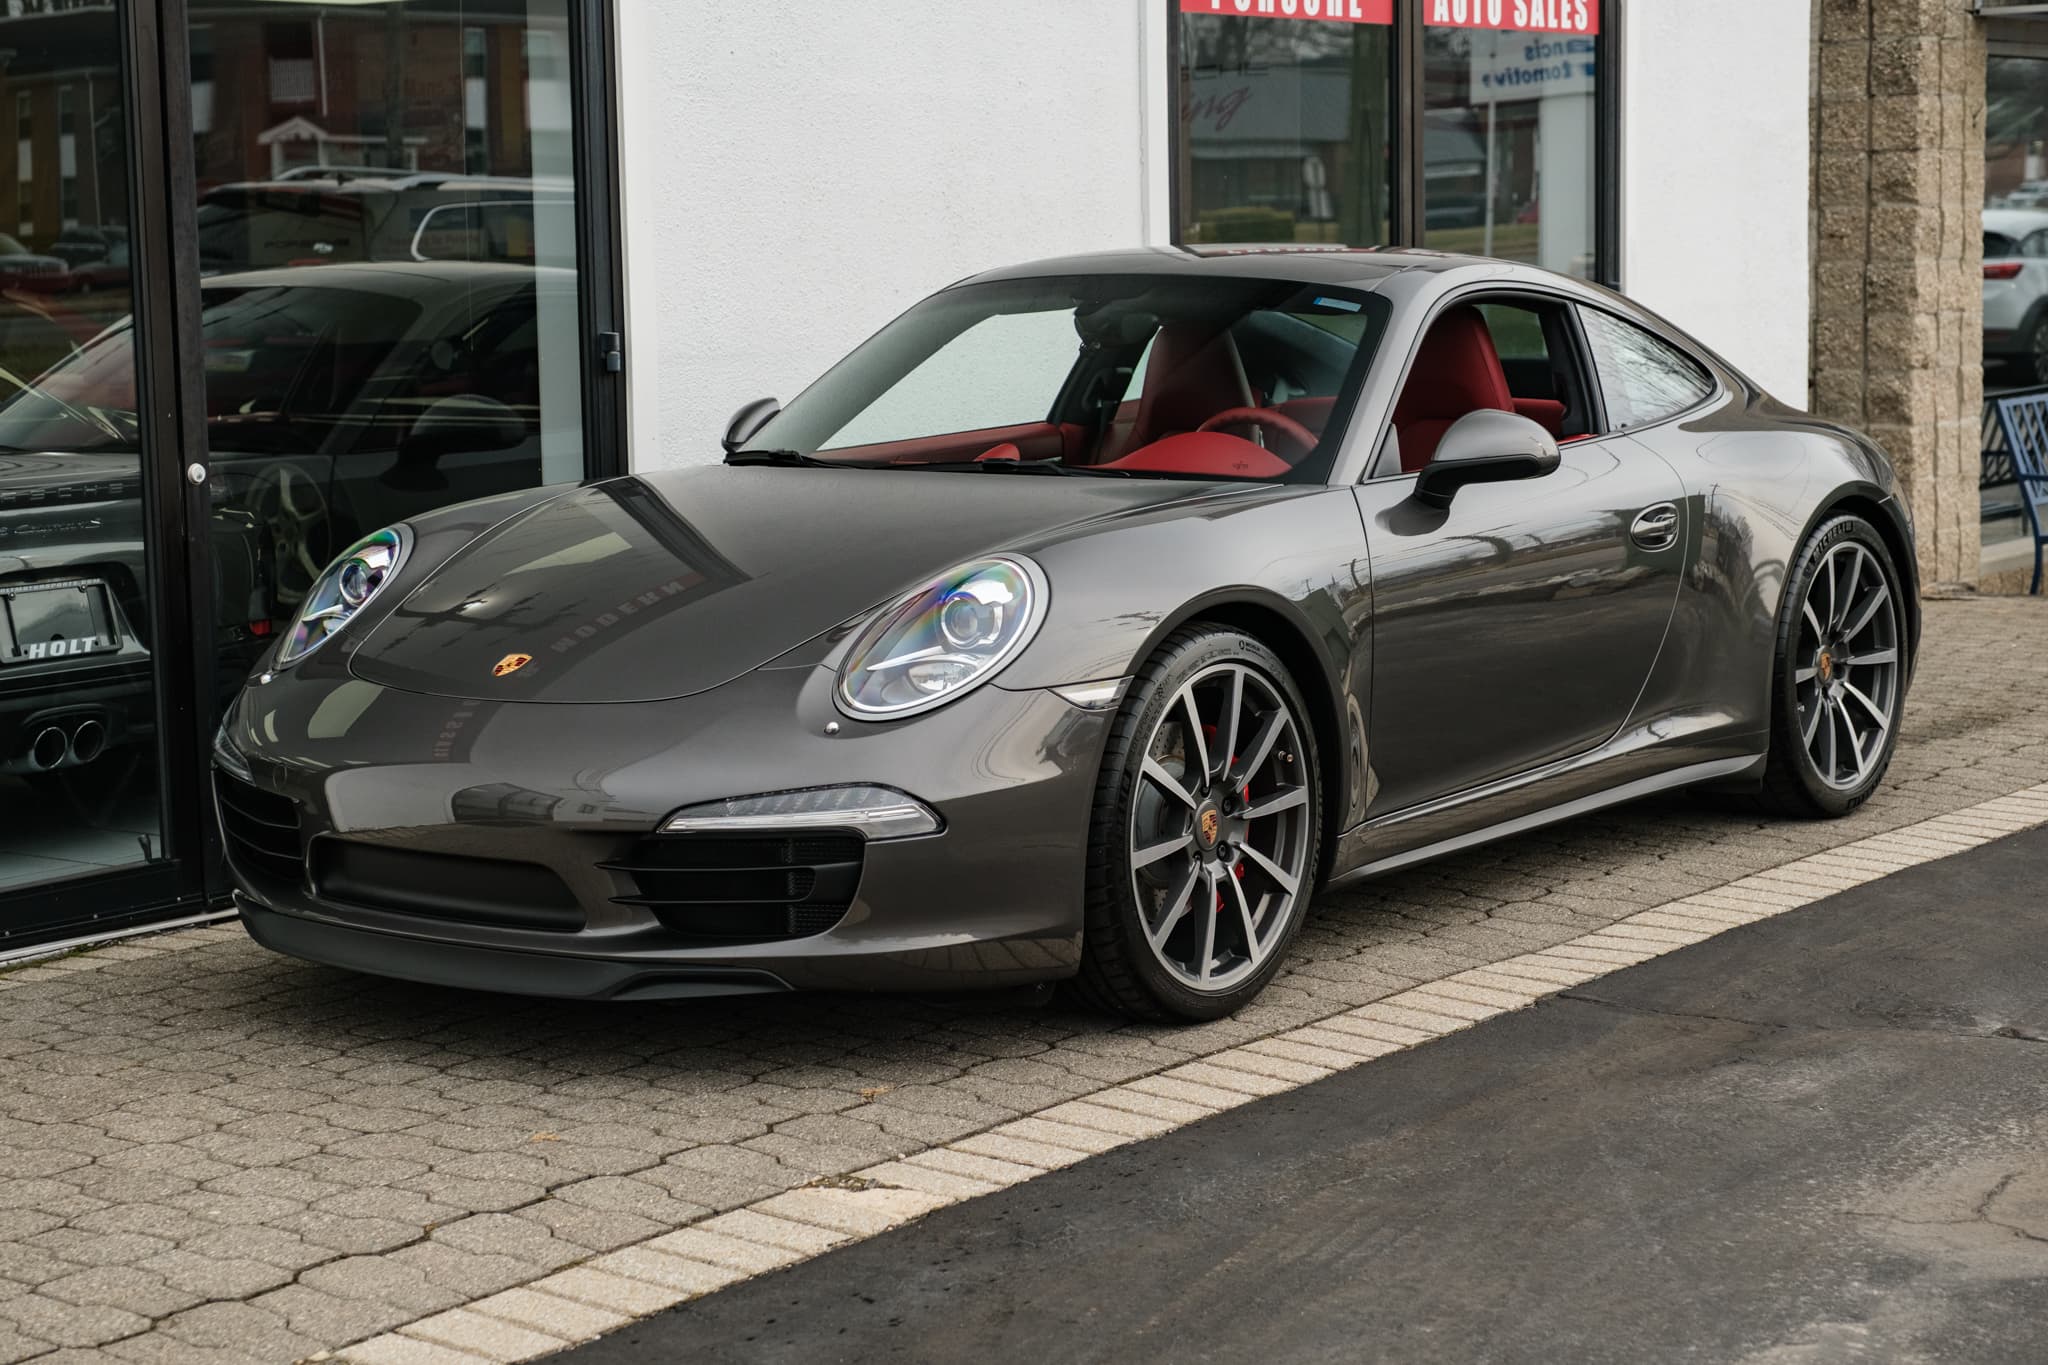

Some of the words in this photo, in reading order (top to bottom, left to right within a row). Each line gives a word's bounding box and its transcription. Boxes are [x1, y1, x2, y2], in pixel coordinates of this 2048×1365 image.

[1433, 0, 1502, 26] AUTO
[1513, 0, 1589, 30] SALES
[28, 636, 98, 659] HOLT
